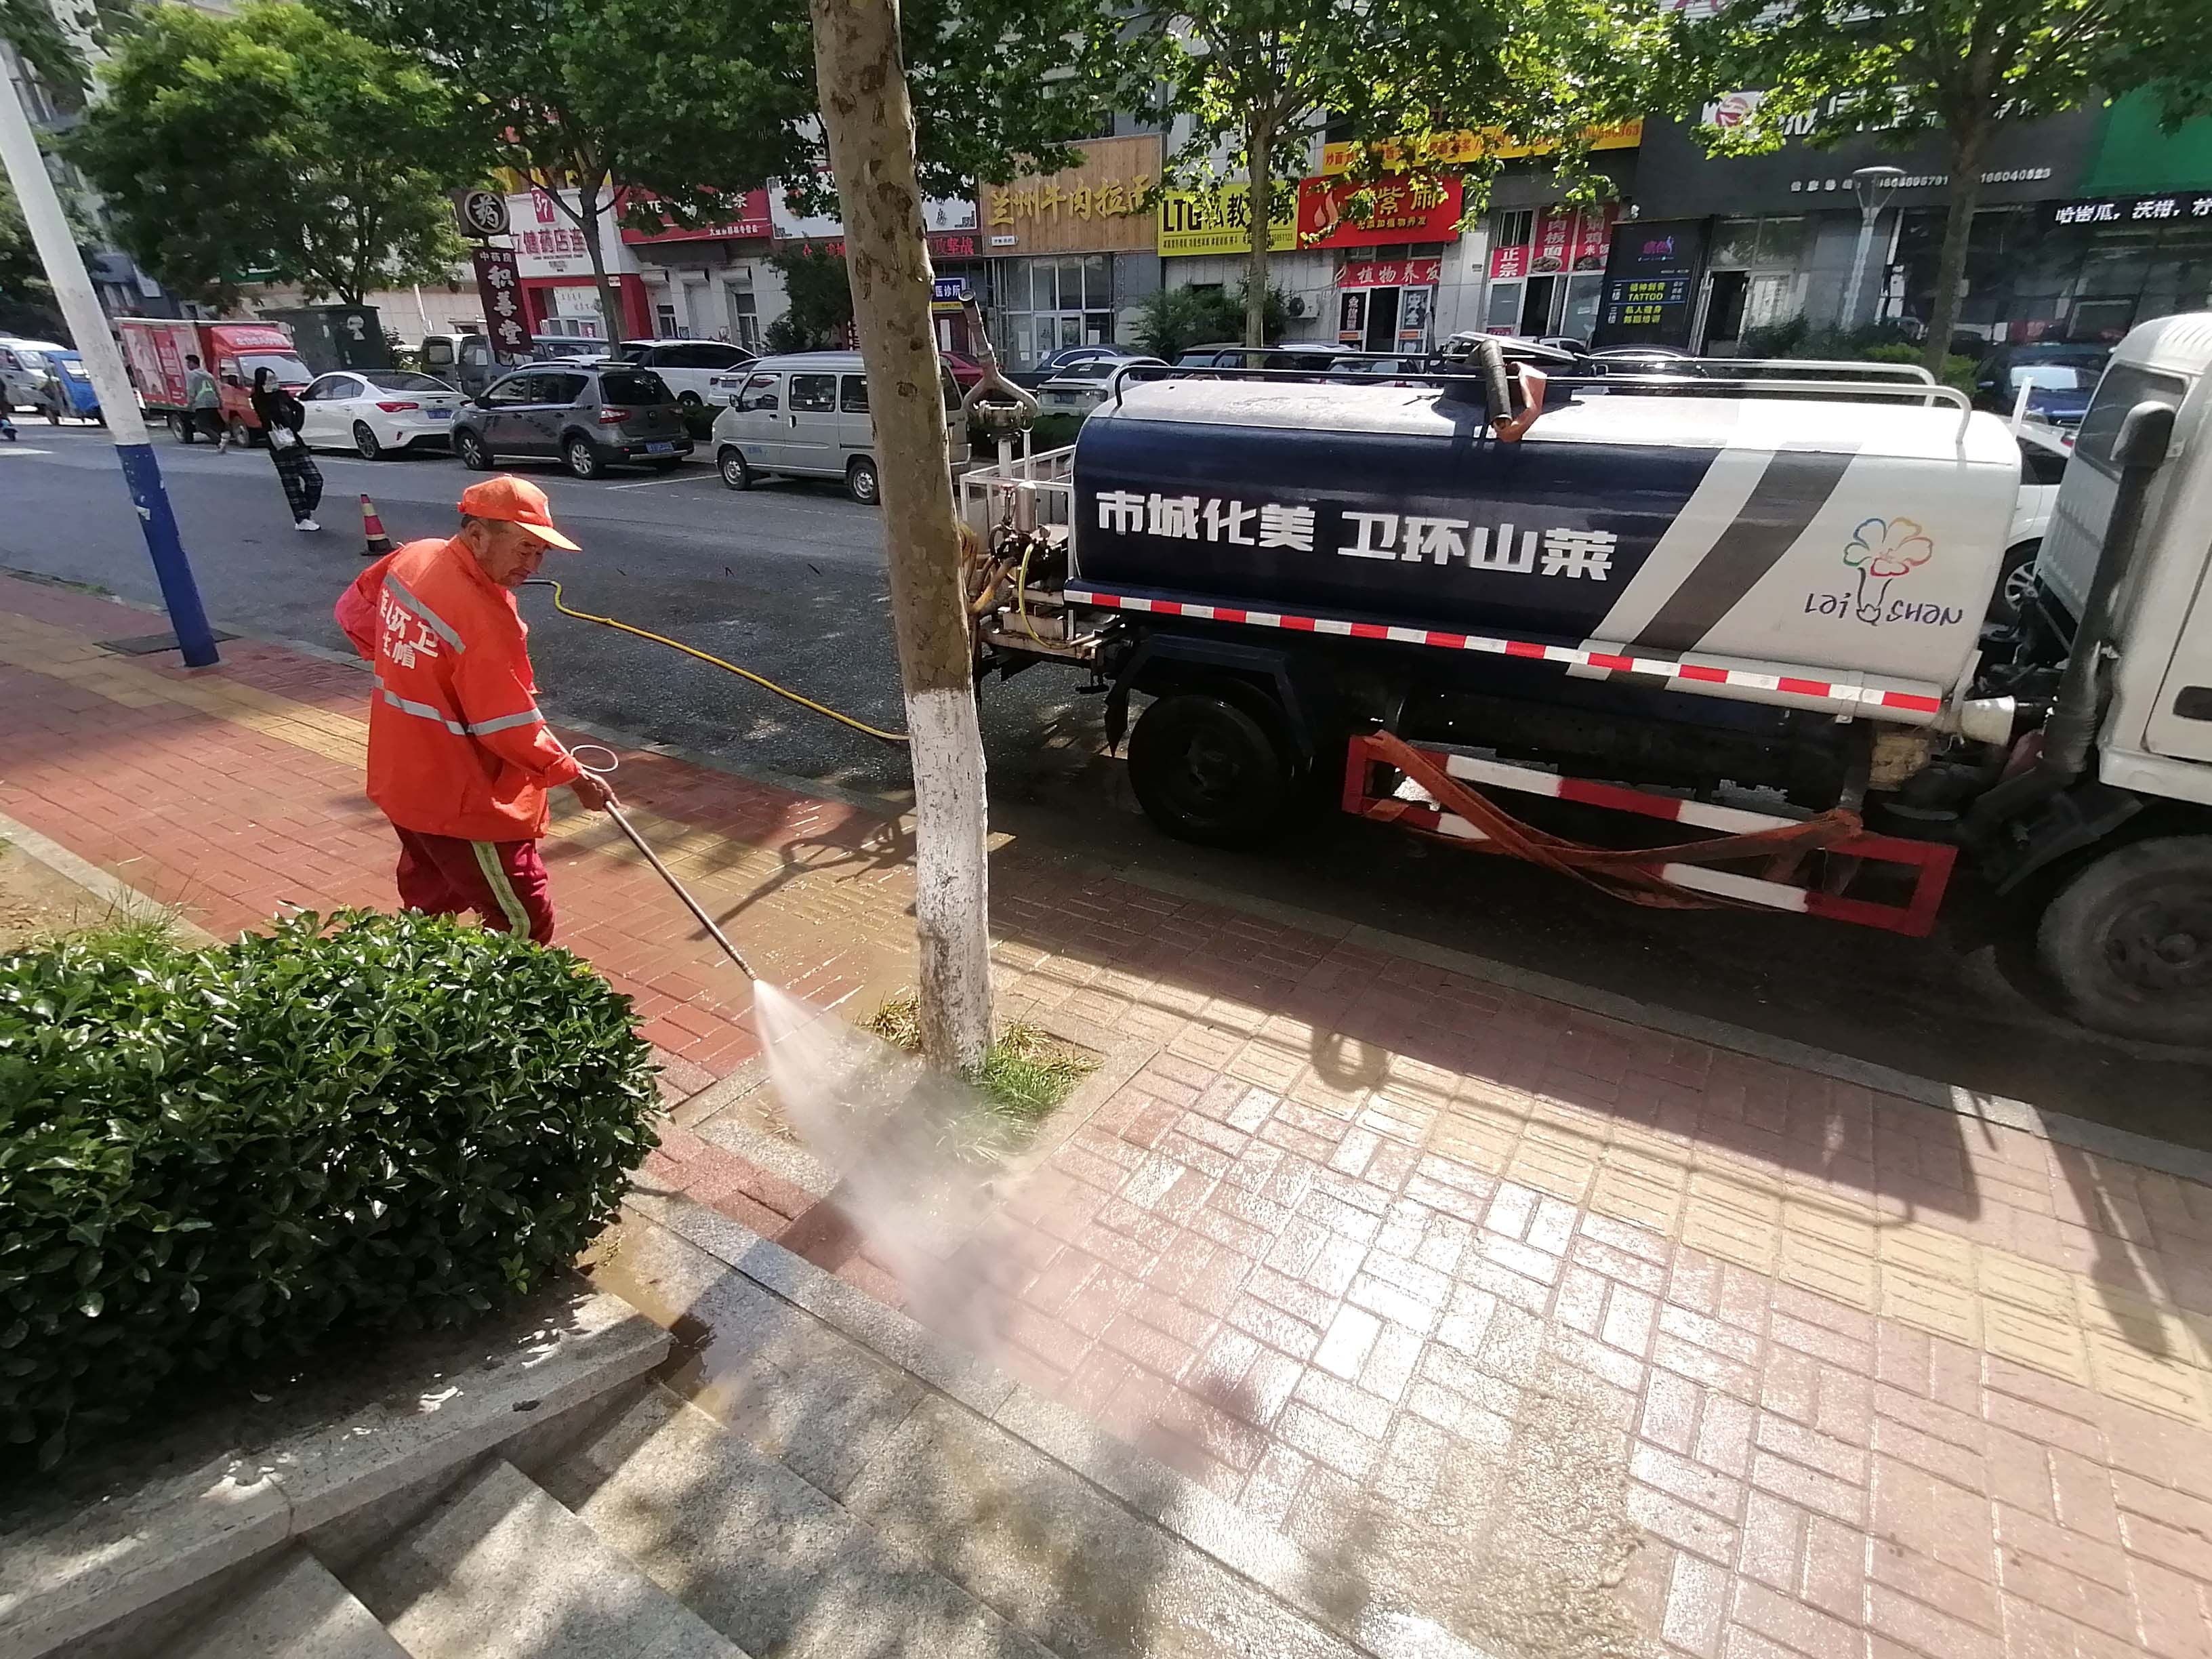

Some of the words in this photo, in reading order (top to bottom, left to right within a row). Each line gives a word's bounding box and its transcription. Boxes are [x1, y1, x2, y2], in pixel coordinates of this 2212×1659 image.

[472, 194, 500, 229] 药
[1544, 216, 1568, 256] 肉板面
[1357, 261, 1441, 284] 植物养发
[1499, 247, 1520, 277] 正宗
[487, 265, 523, 345] 积善堂
[1628, 292, 1664, 302] TATTOO
